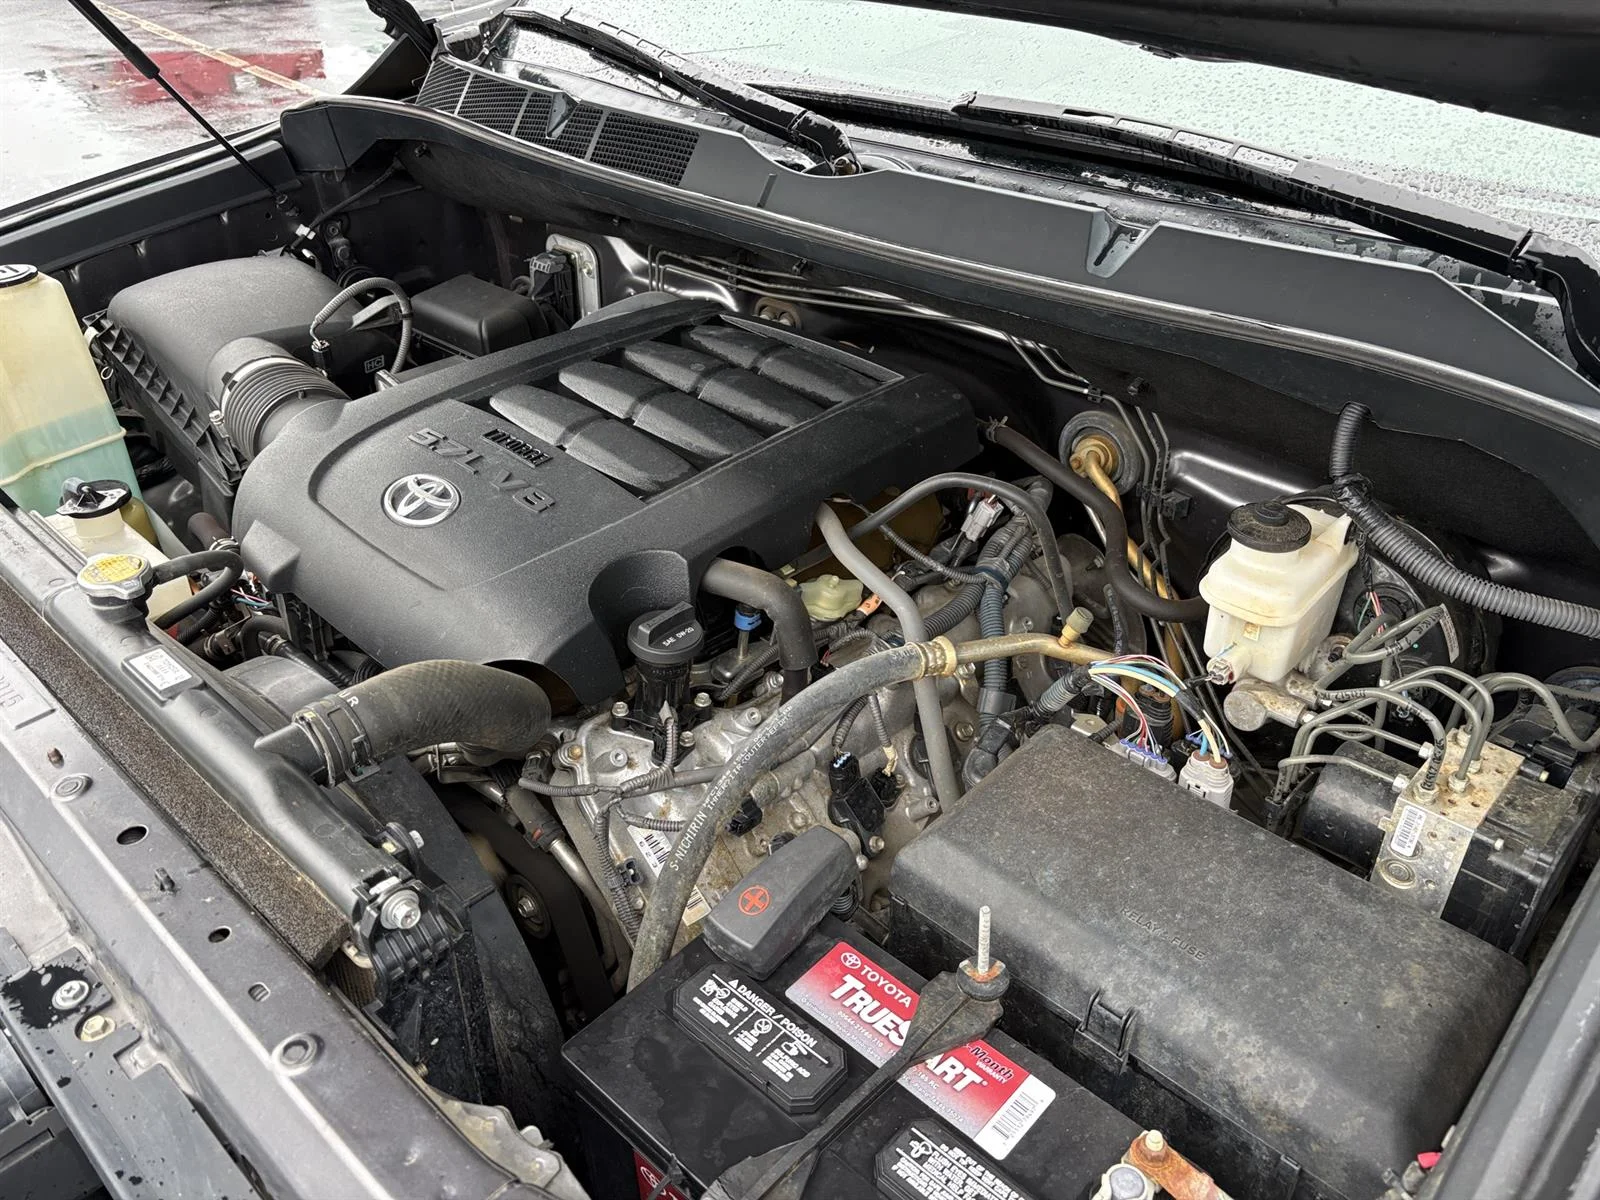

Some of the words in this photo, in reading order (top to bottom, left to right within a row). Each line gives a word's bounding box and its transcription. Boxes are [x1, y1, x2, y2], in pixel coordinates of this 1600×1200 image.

[408, 427, 484, 475] 5.7L
[491, 469, 556, 513] V8
[662, 636, 676, 646] SAE
[1171, 936, 1208, 961] FUSE
[860, 965, 912, 1008] TOYOTA
[737, 985, 776, 1016] DANGER
[780, 1018, 818, 1048] POISON
[976, 1061, 1008, 1084] WARRANTY
[923, 1161, 948, 1184] MEDICAL
[947, 1180, 964, 1195] HELP
[928, 1156, 944, 1172] WITH
[964, 1184, 978, 1198] GET
[932, 1150, 952, 1169] FLUSH
[950, 1165, 968, 1180] EYES
